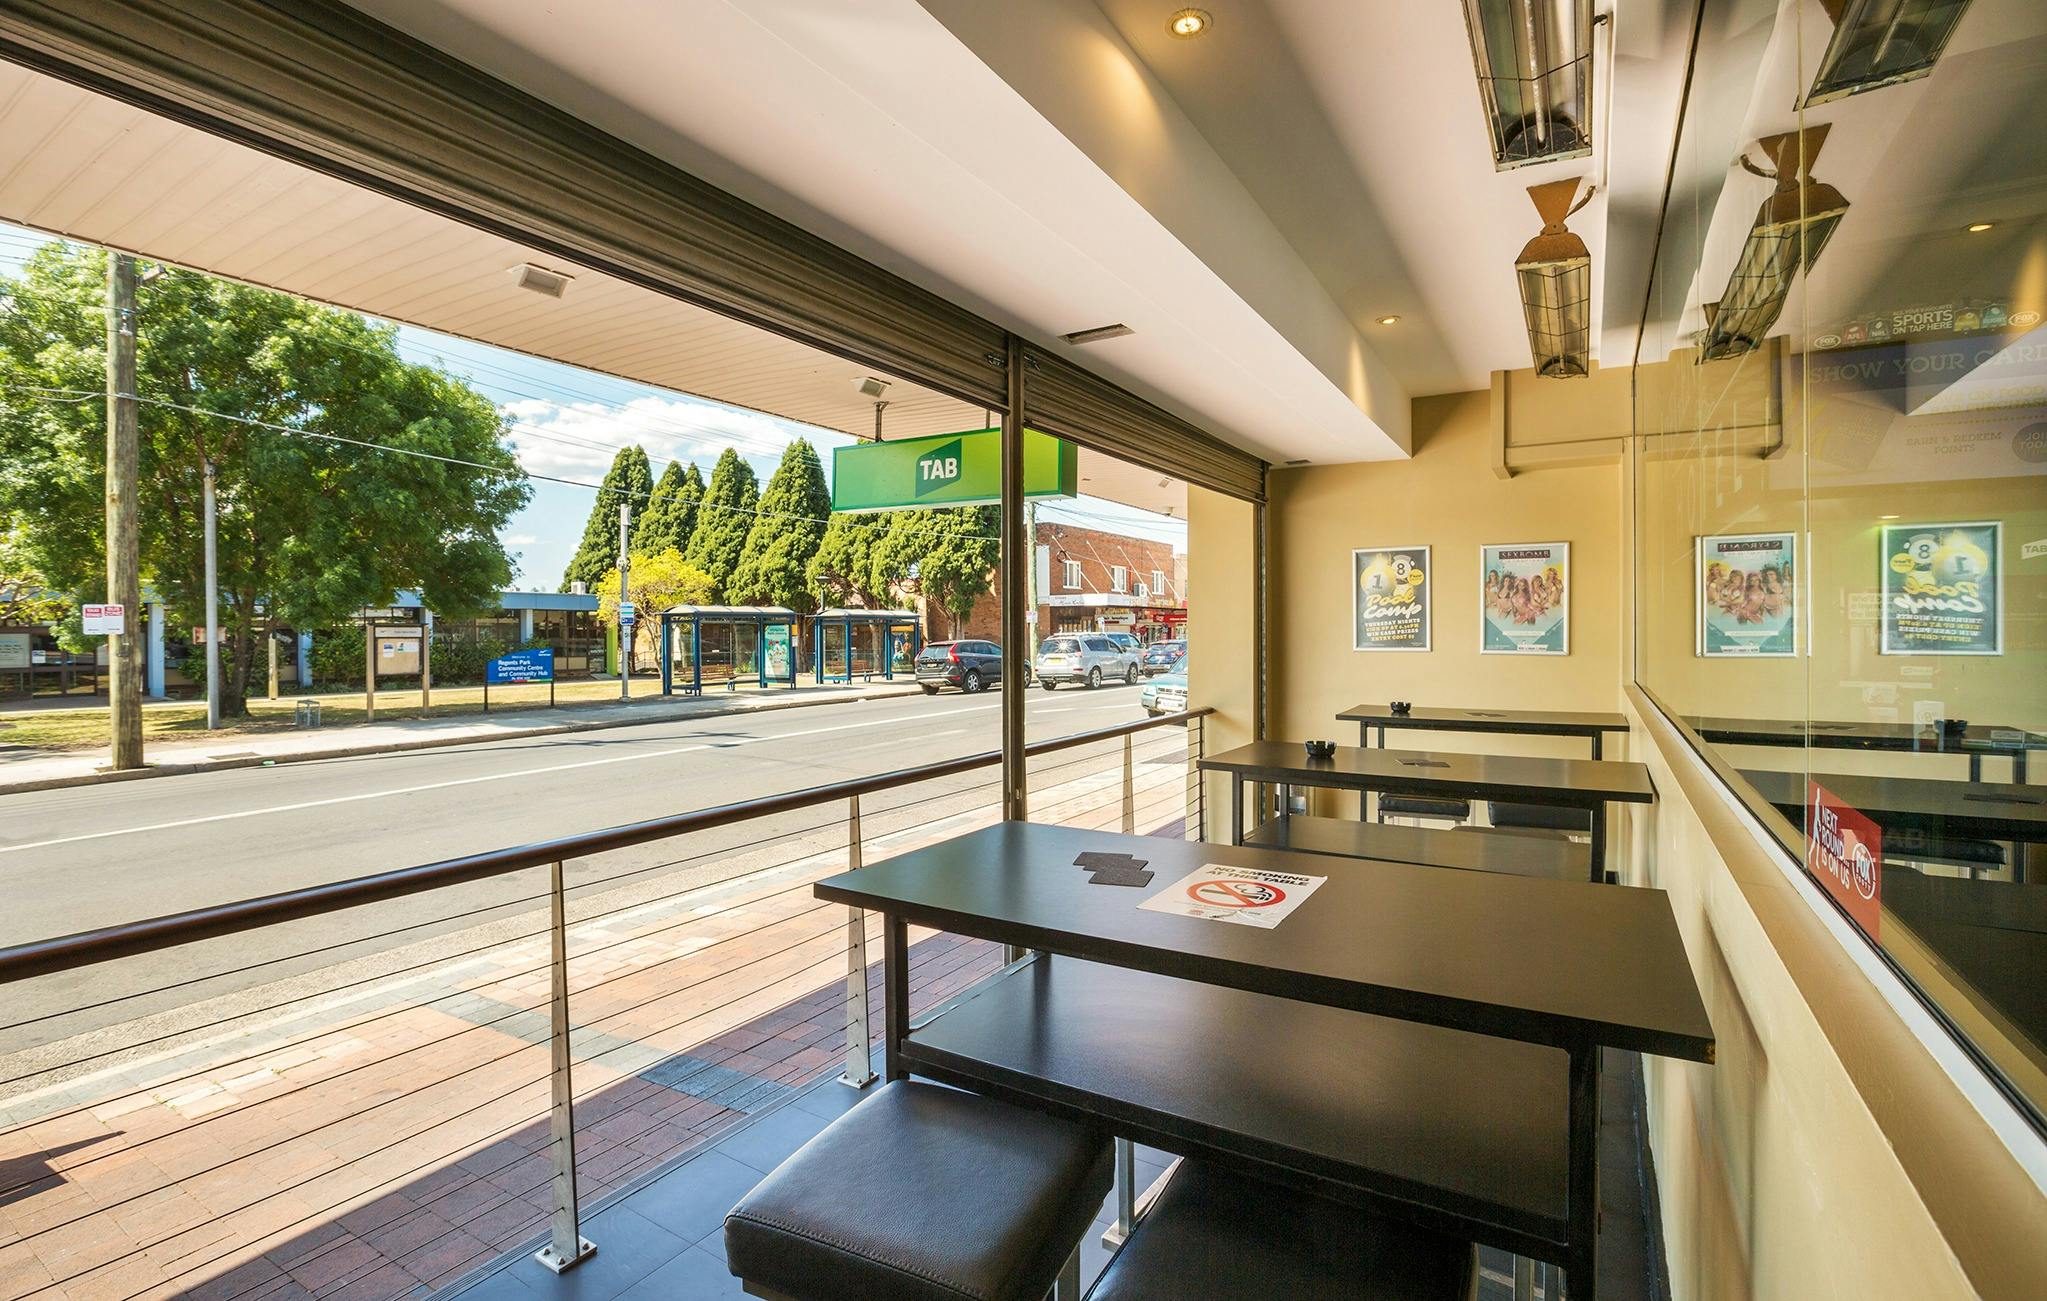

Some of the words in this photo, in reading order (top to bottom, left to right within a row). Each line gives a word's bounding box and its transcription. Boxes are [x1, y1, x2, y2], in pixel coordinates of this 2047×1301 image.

[1892, 310, 1953, 327] SPORTS
[1908, 324, 1926, 332] TAP
[1926, 321, 1952, 330] HERE
[1810, 360, 1884, 384] SHOW
[1893, 353, 1965, 374] YOUR
[1934, 444, 1976, 454] POINTS
[920, 458, 958, 480] TAB
[2024, 544, 2047, 552] TAB
[1397, 563, 1405, 576] 8
[1372, 574, 1382, 589] 1
[1366, 588, 1416, 607] Pool
[1364, 602, 1422, 619] Comp
[1822, 804, 1838, 834] NEXT
[1822, 825, 1844, 861] ROUND
[1822, 846, 1827, 866] IS
[1829, 853, 1838, 878] ON
[1840, 863, 1849, 889] US
[1856, 850, 1870, 884] FOX
[1240, 870, 1310, 882] SMOKING
[1263, 877, 1310, 886] TABLE
